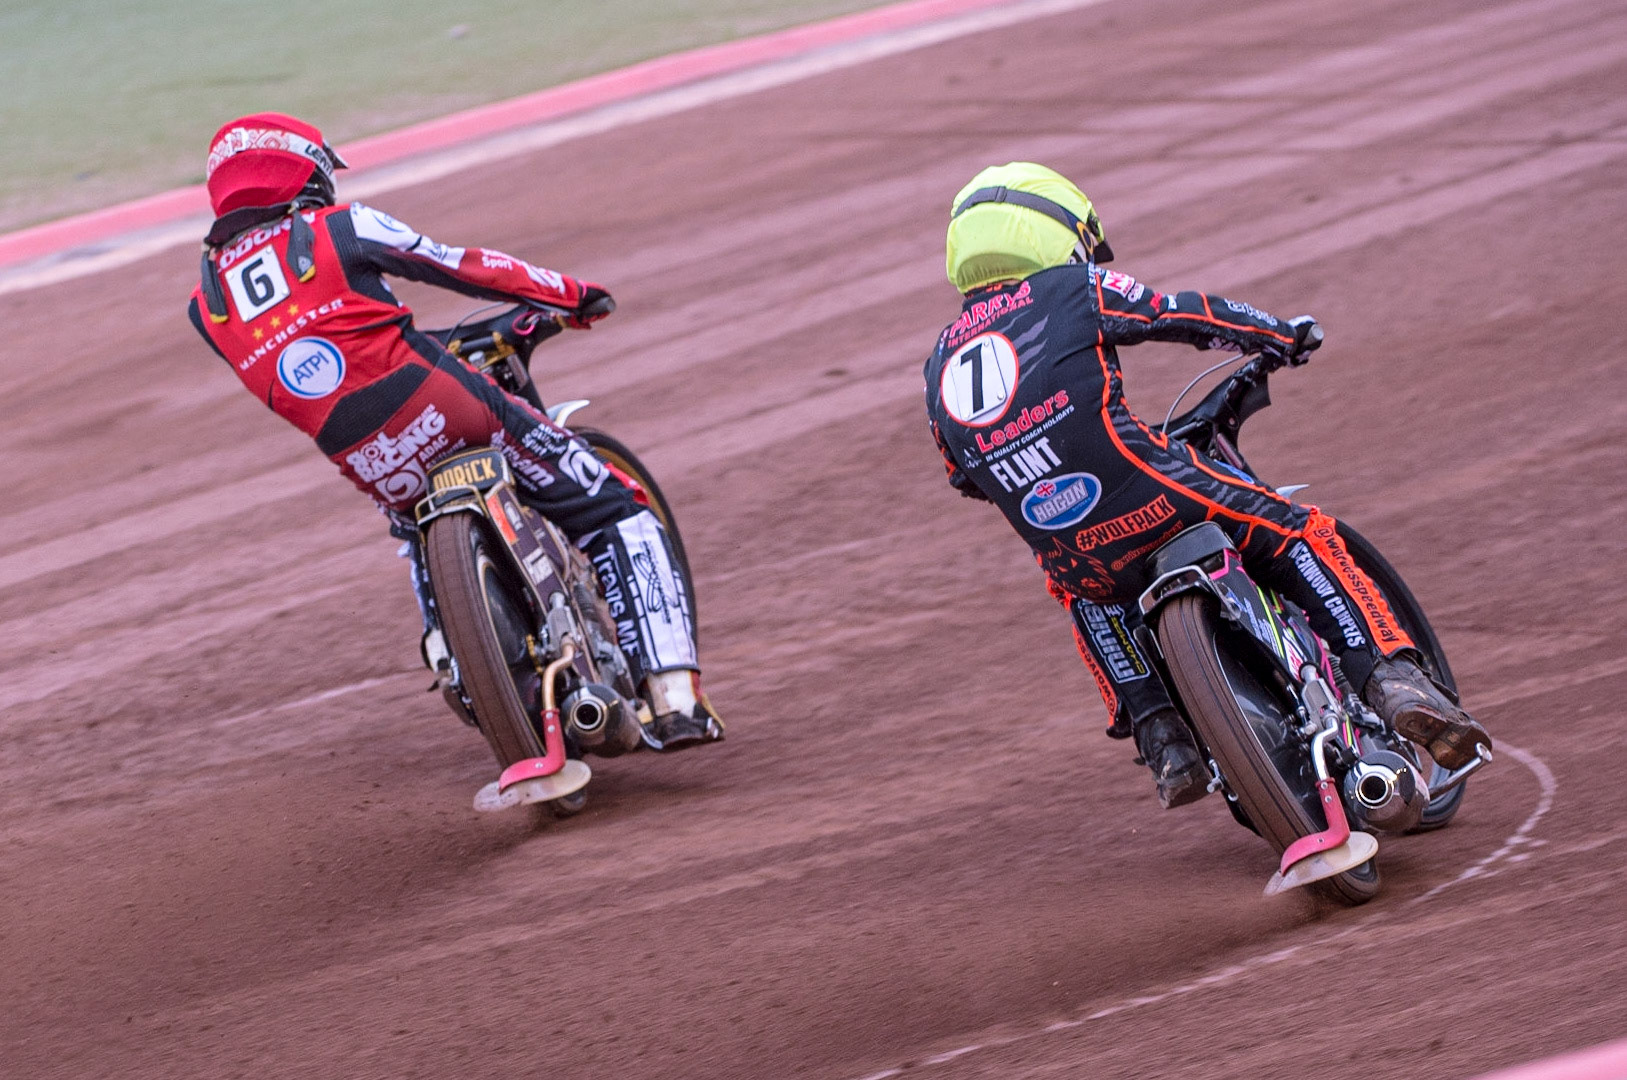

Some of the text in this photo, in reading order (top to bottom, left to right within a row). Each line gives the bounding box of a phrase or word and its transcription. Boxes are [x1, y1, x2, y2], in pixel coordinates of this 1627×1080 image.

[241, 258, 275, 307] 6
[239, 298, 344, 371] MANCHESTER
[293, 351, 330, 386] ATPI
[960, 342, 984, 414] 7
[418, 434, 449, 463] ADAC
[975, 389, 1069, 453] Leaders
[985, 404, 1075, 462] IN QUALITY COACH HOLIDAYS
[989, 436, 1062, 492] FLINT
[1078, 495, 1175, 550] #WOLFPACK
